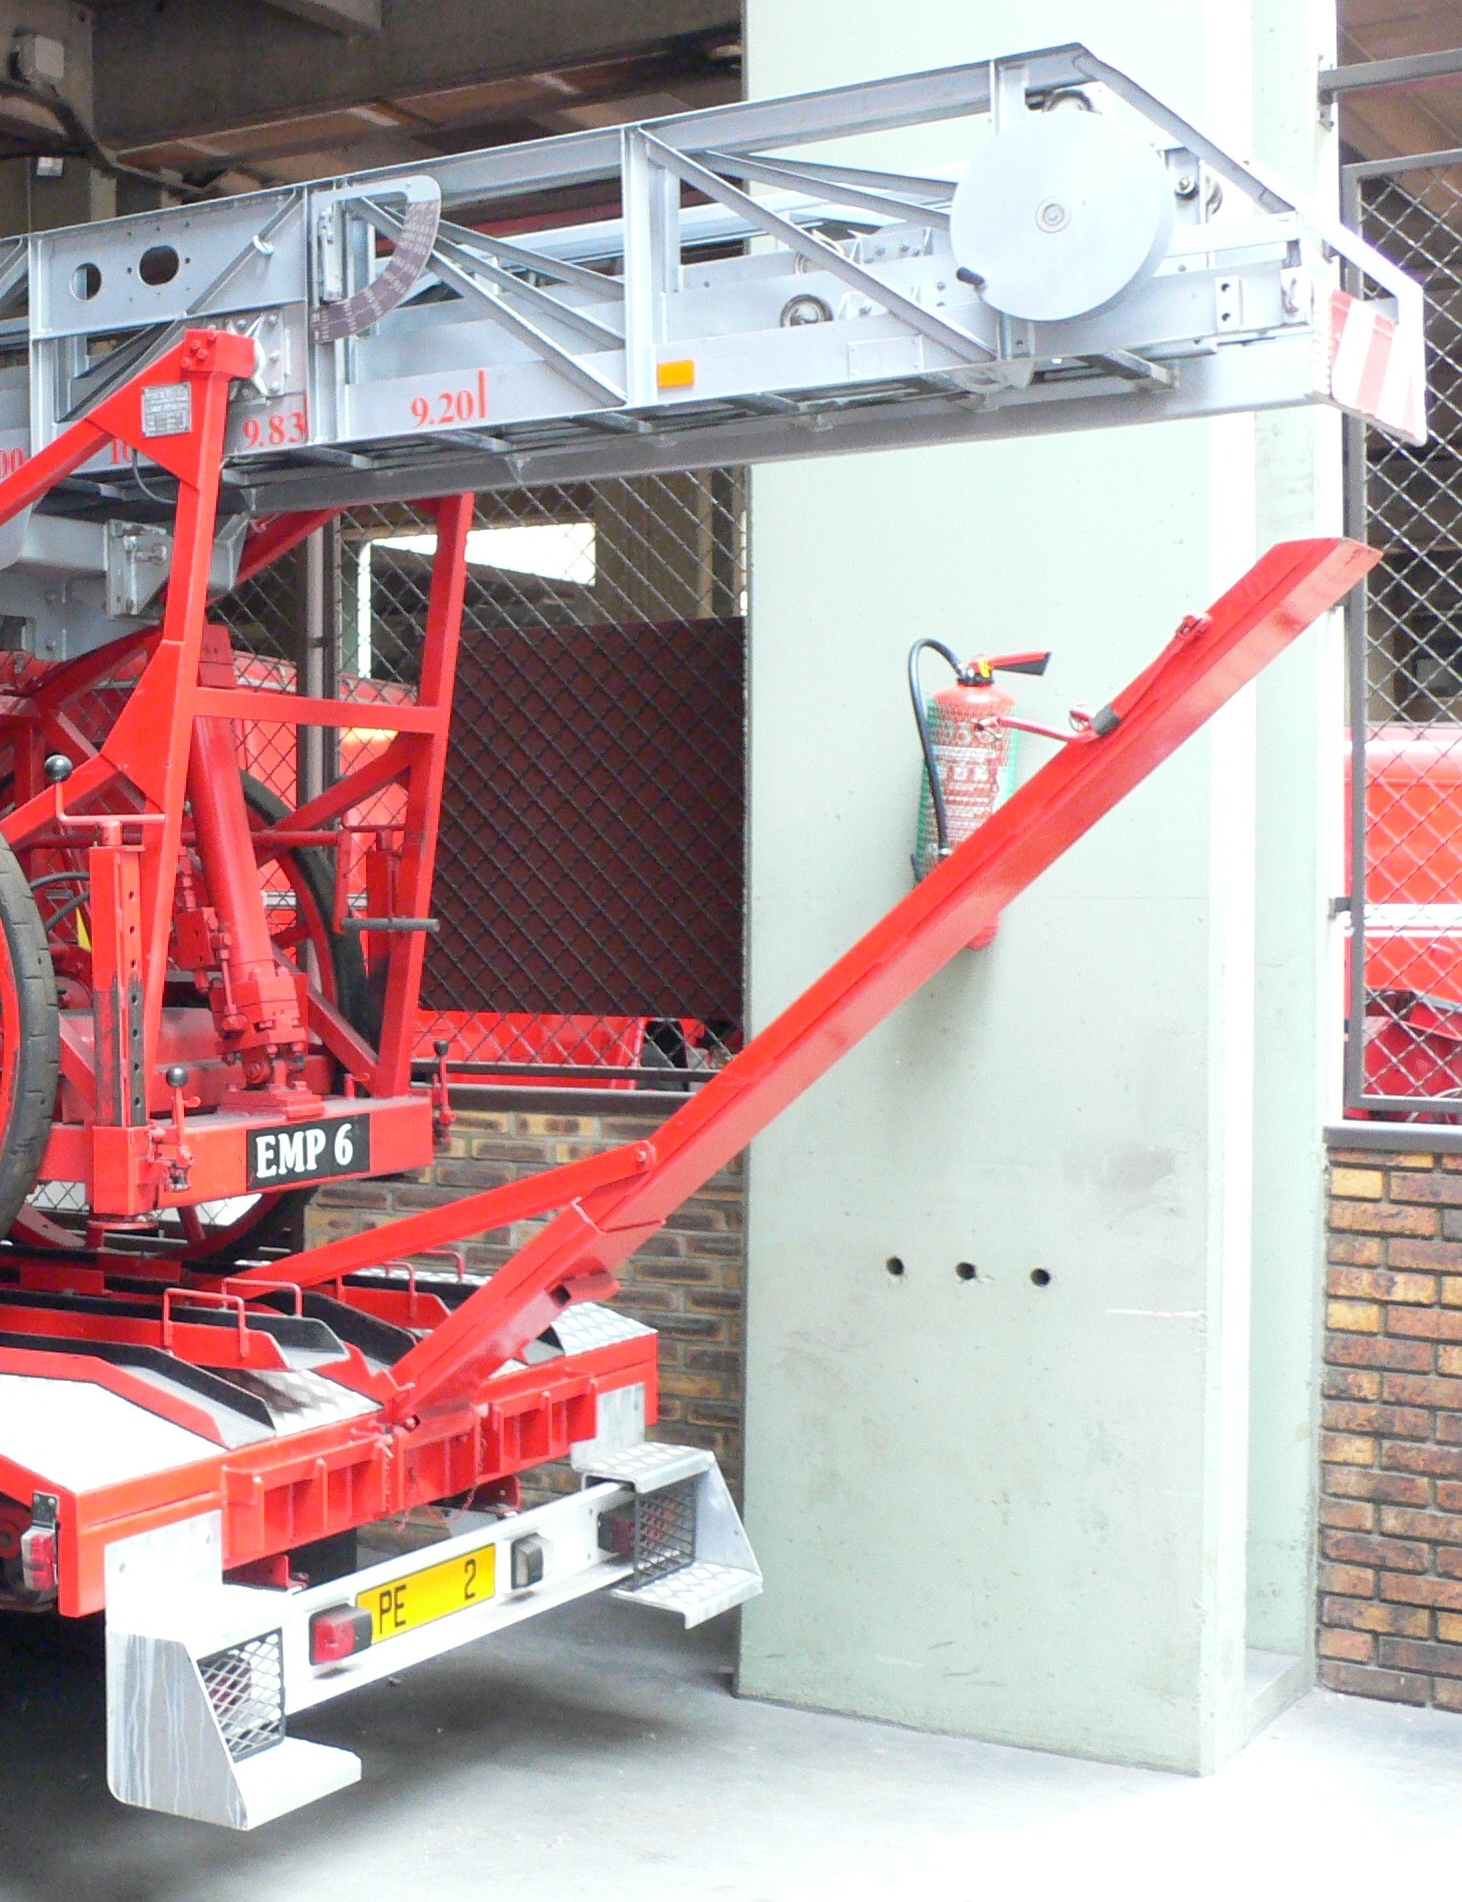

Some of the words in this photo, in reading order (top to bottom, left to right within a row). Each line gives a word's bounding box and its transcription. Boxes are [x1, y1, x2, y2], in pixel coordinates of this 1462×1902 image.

[243, 410, 306, 448] 9.83
[410, 389, 475, 428] 9.20
[255, 1128, 326, 1178] EMP
[334, 1123, 354, 1166] 6
[378, 1584, 406, 1634] PE
[463, 1558, 477, 1601] 2
